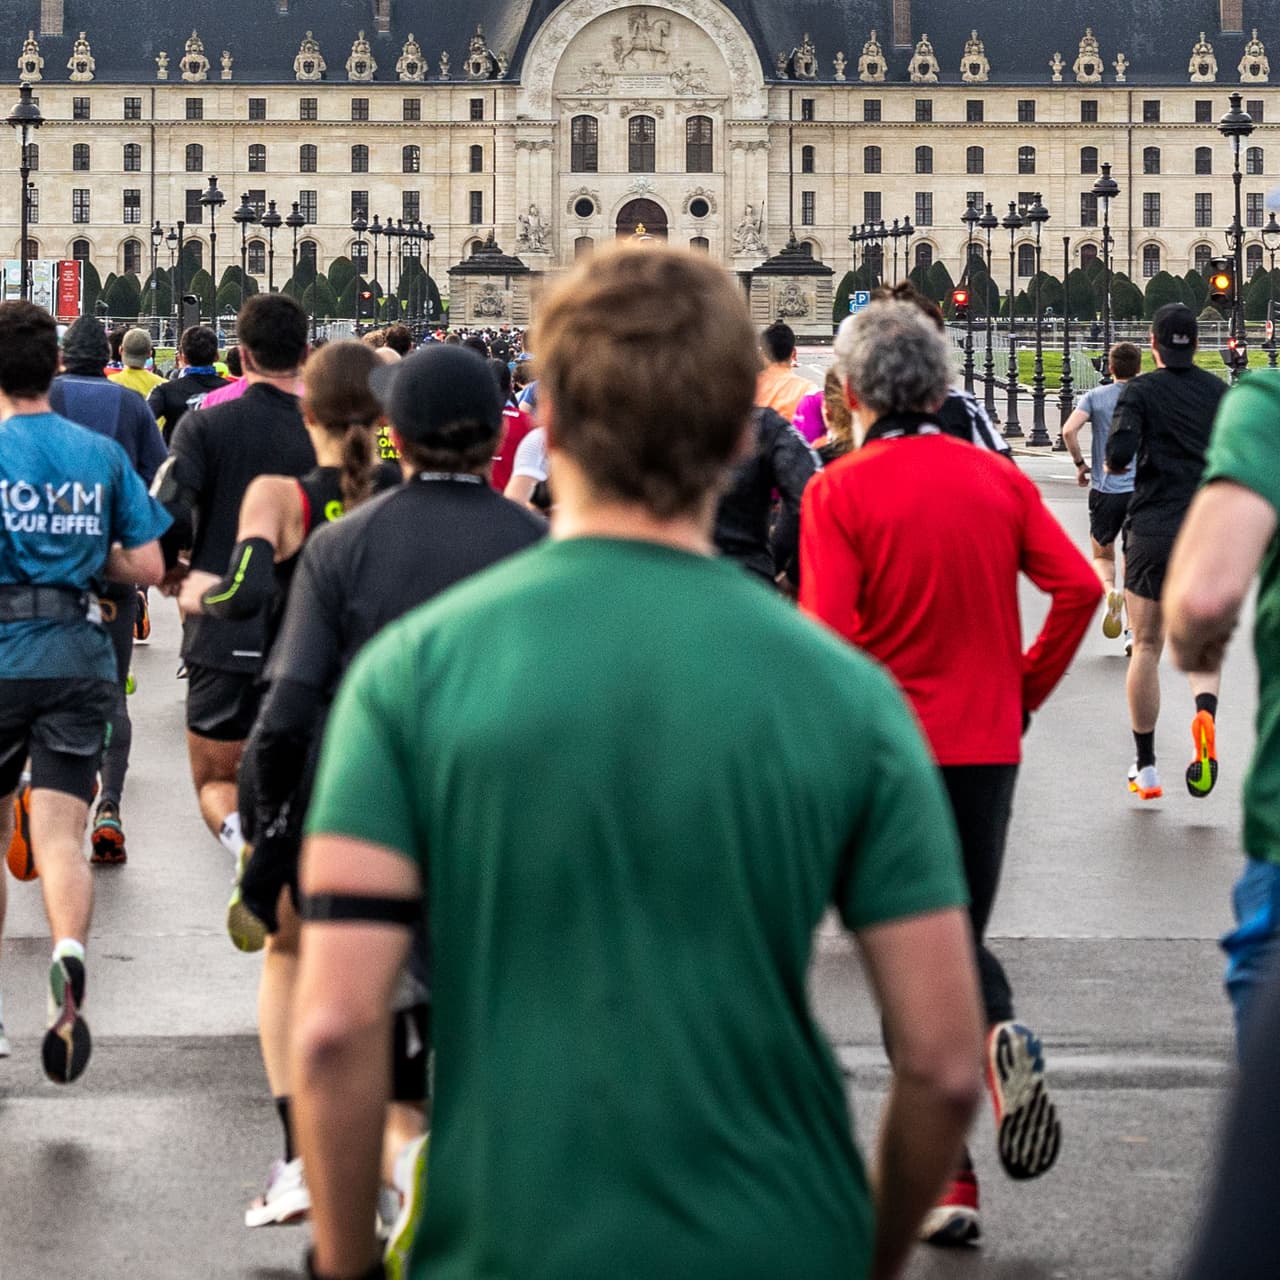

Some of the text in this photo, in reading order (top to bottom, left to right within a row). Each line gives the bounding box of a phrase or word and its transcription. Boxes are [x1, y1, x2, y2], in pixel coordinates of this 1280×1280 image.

[0, 479, 103, 513] 10 KM
[2, 510, 102, 535] TOUR EIFFEL
